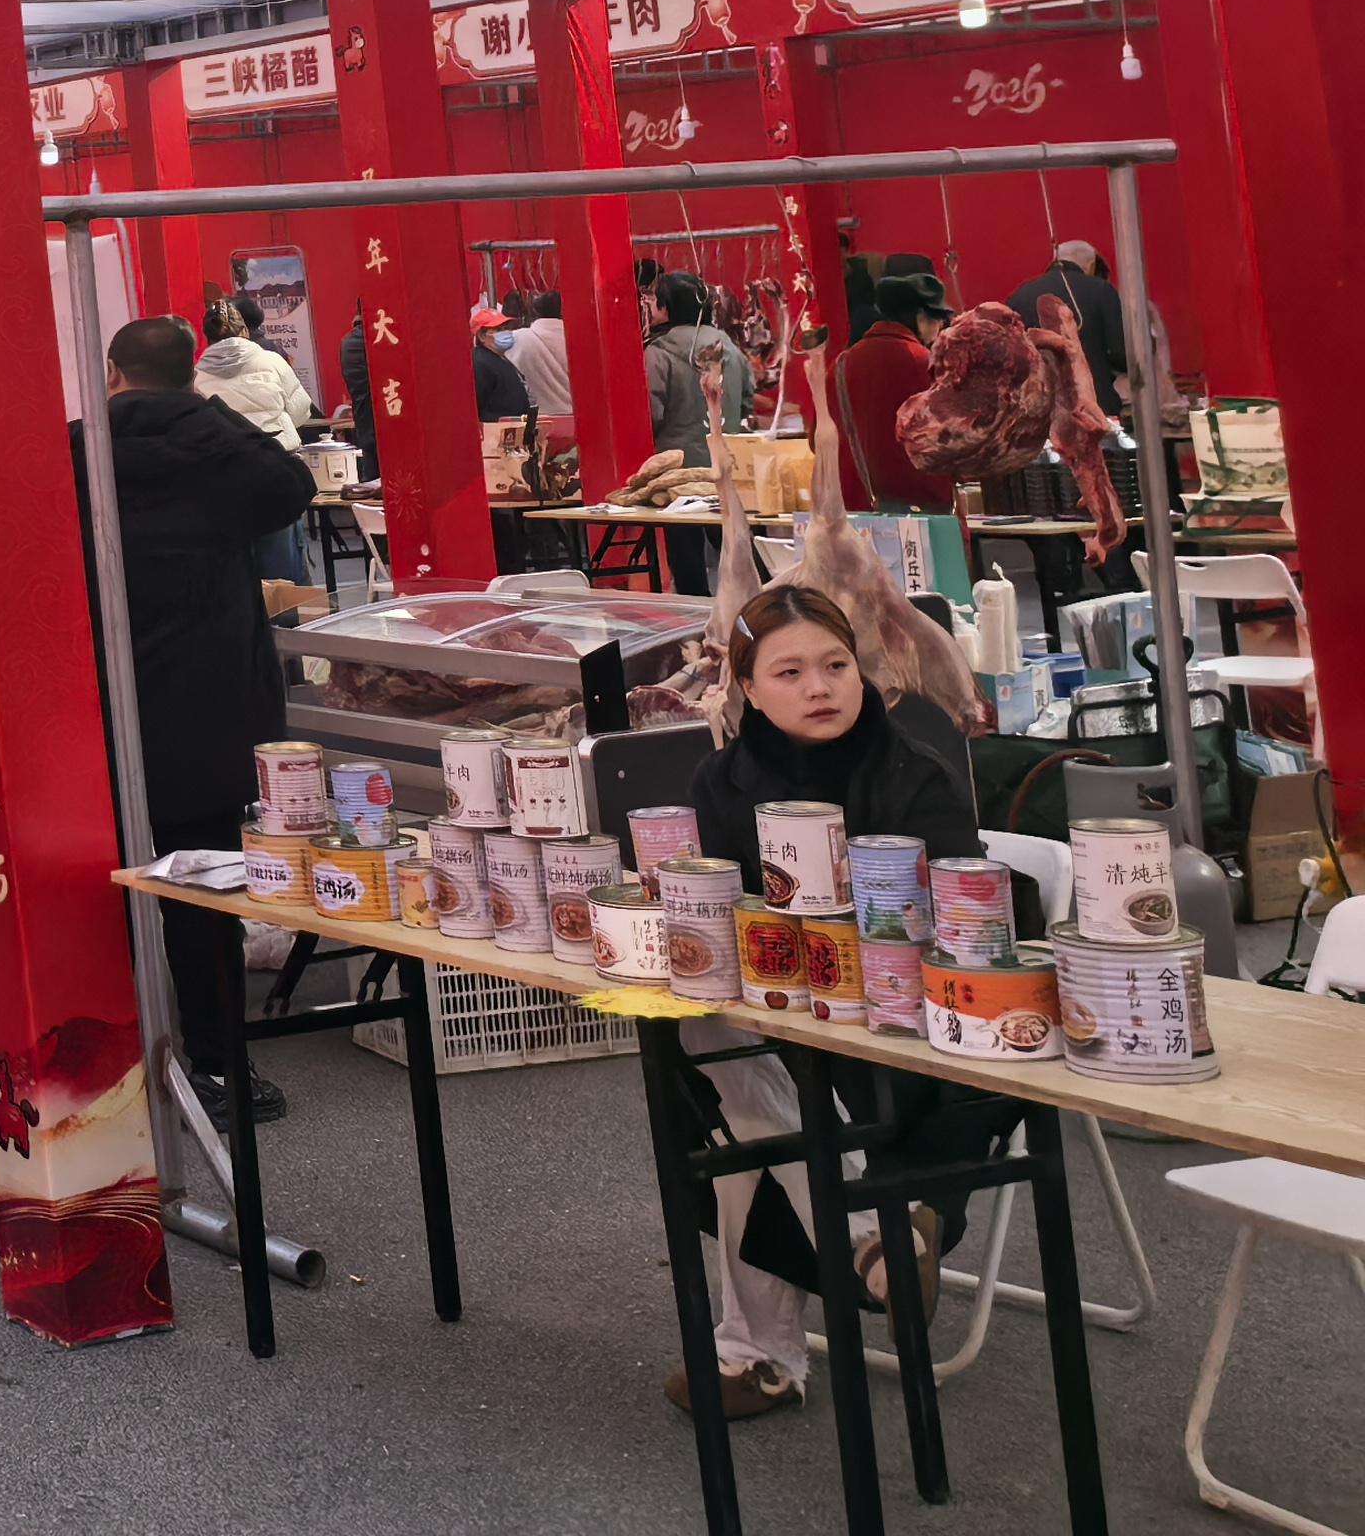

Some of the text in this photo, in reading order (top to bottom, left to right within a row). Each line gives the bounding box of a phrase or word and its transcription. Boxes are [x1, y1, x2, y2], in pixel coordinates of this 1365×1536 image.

[203, 45, 319, 98] 三峡橘醋
[966, 64, 1046, 115] 2026
[759, 838, 798, 863] 羊肉
[1156, 967, 1187, 1055] 全鸡汤
